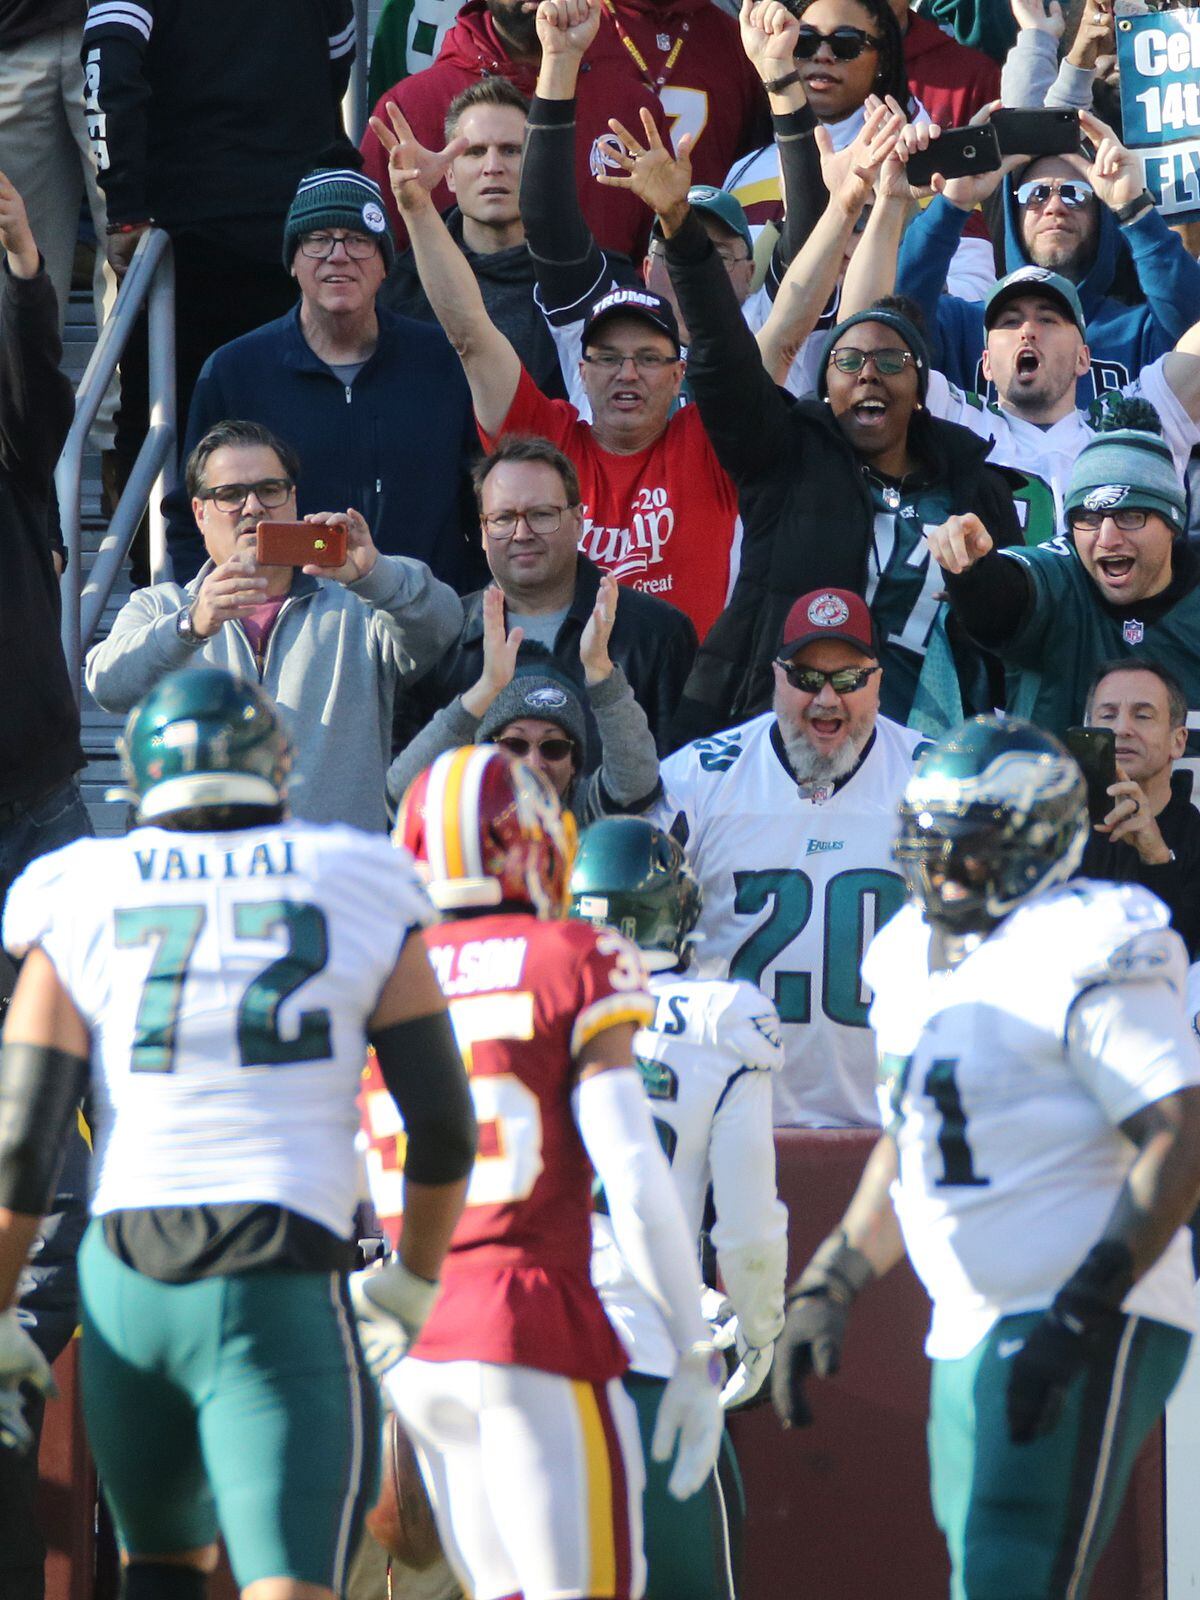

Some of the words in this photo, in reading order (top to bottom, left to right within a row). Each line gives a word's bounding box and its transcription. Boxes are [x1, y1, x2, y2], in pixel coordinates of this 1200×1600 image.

[592, 290, 661, 316] TRUMP
[806, 838, 845, 856] EAGLES
[113, 898, 334, 1074] 72
